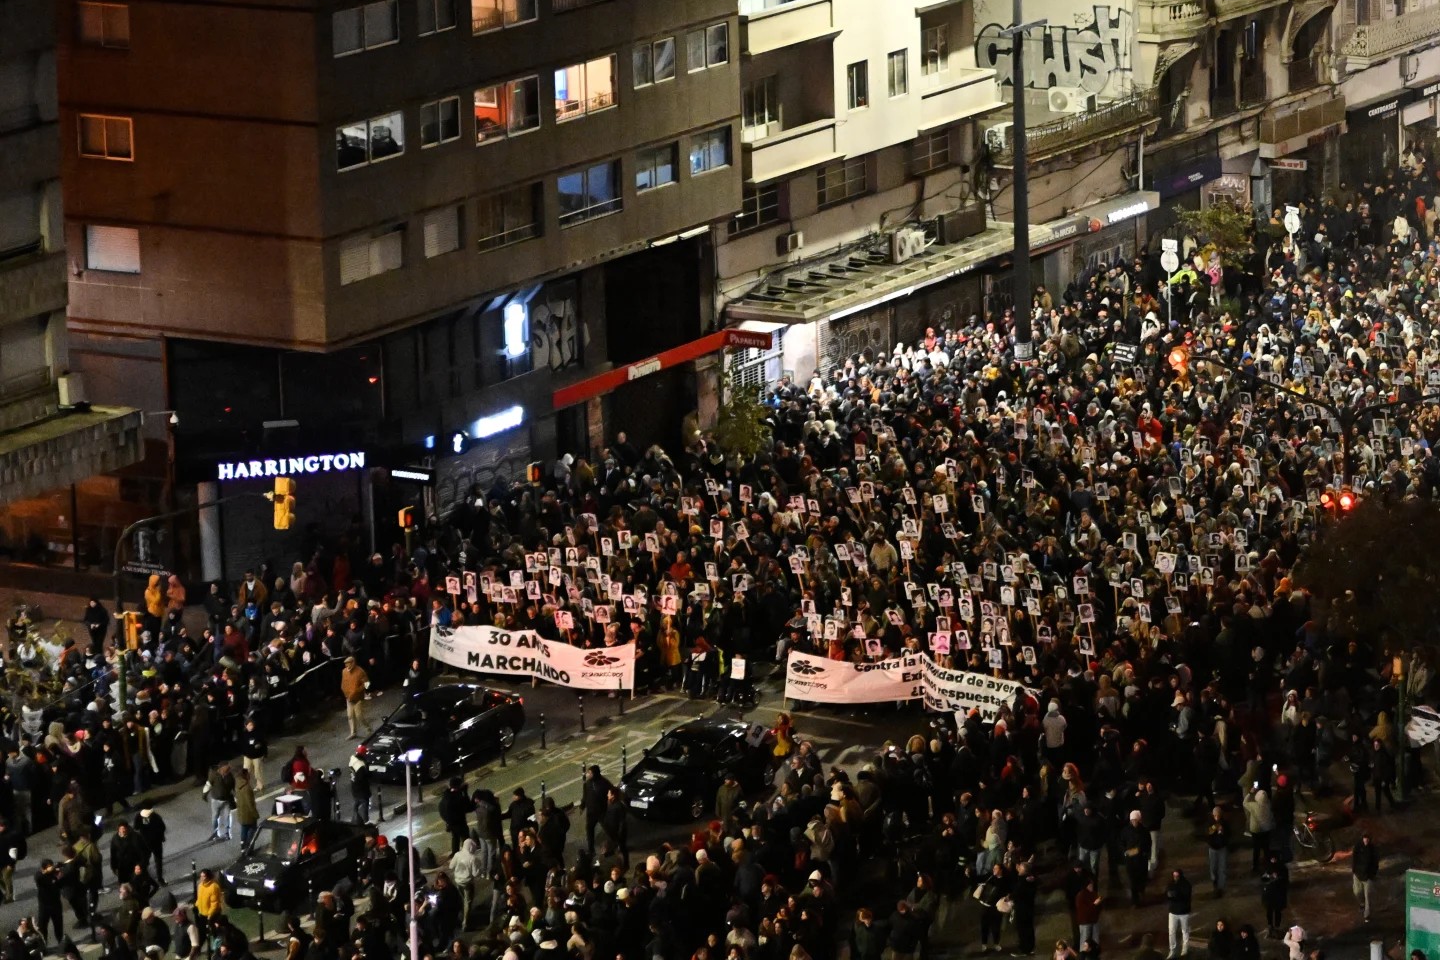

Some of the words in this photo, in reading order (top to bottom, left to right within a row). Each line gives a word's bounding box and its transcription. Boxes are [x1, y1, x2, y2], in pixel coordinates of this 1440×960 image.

[218, 451, 365, 480] HARRINGTON
[488, 631, 511, 645] 30
[467, 652, 571, 684] MARCHANDO
[854, 661, 900, 672] Contra
[904, 657, 916, 667] la
[967, 676, 983, 687] de
[987, 680, 1015, 694] ayer
[938, 687, 1007, 706] respuestas
